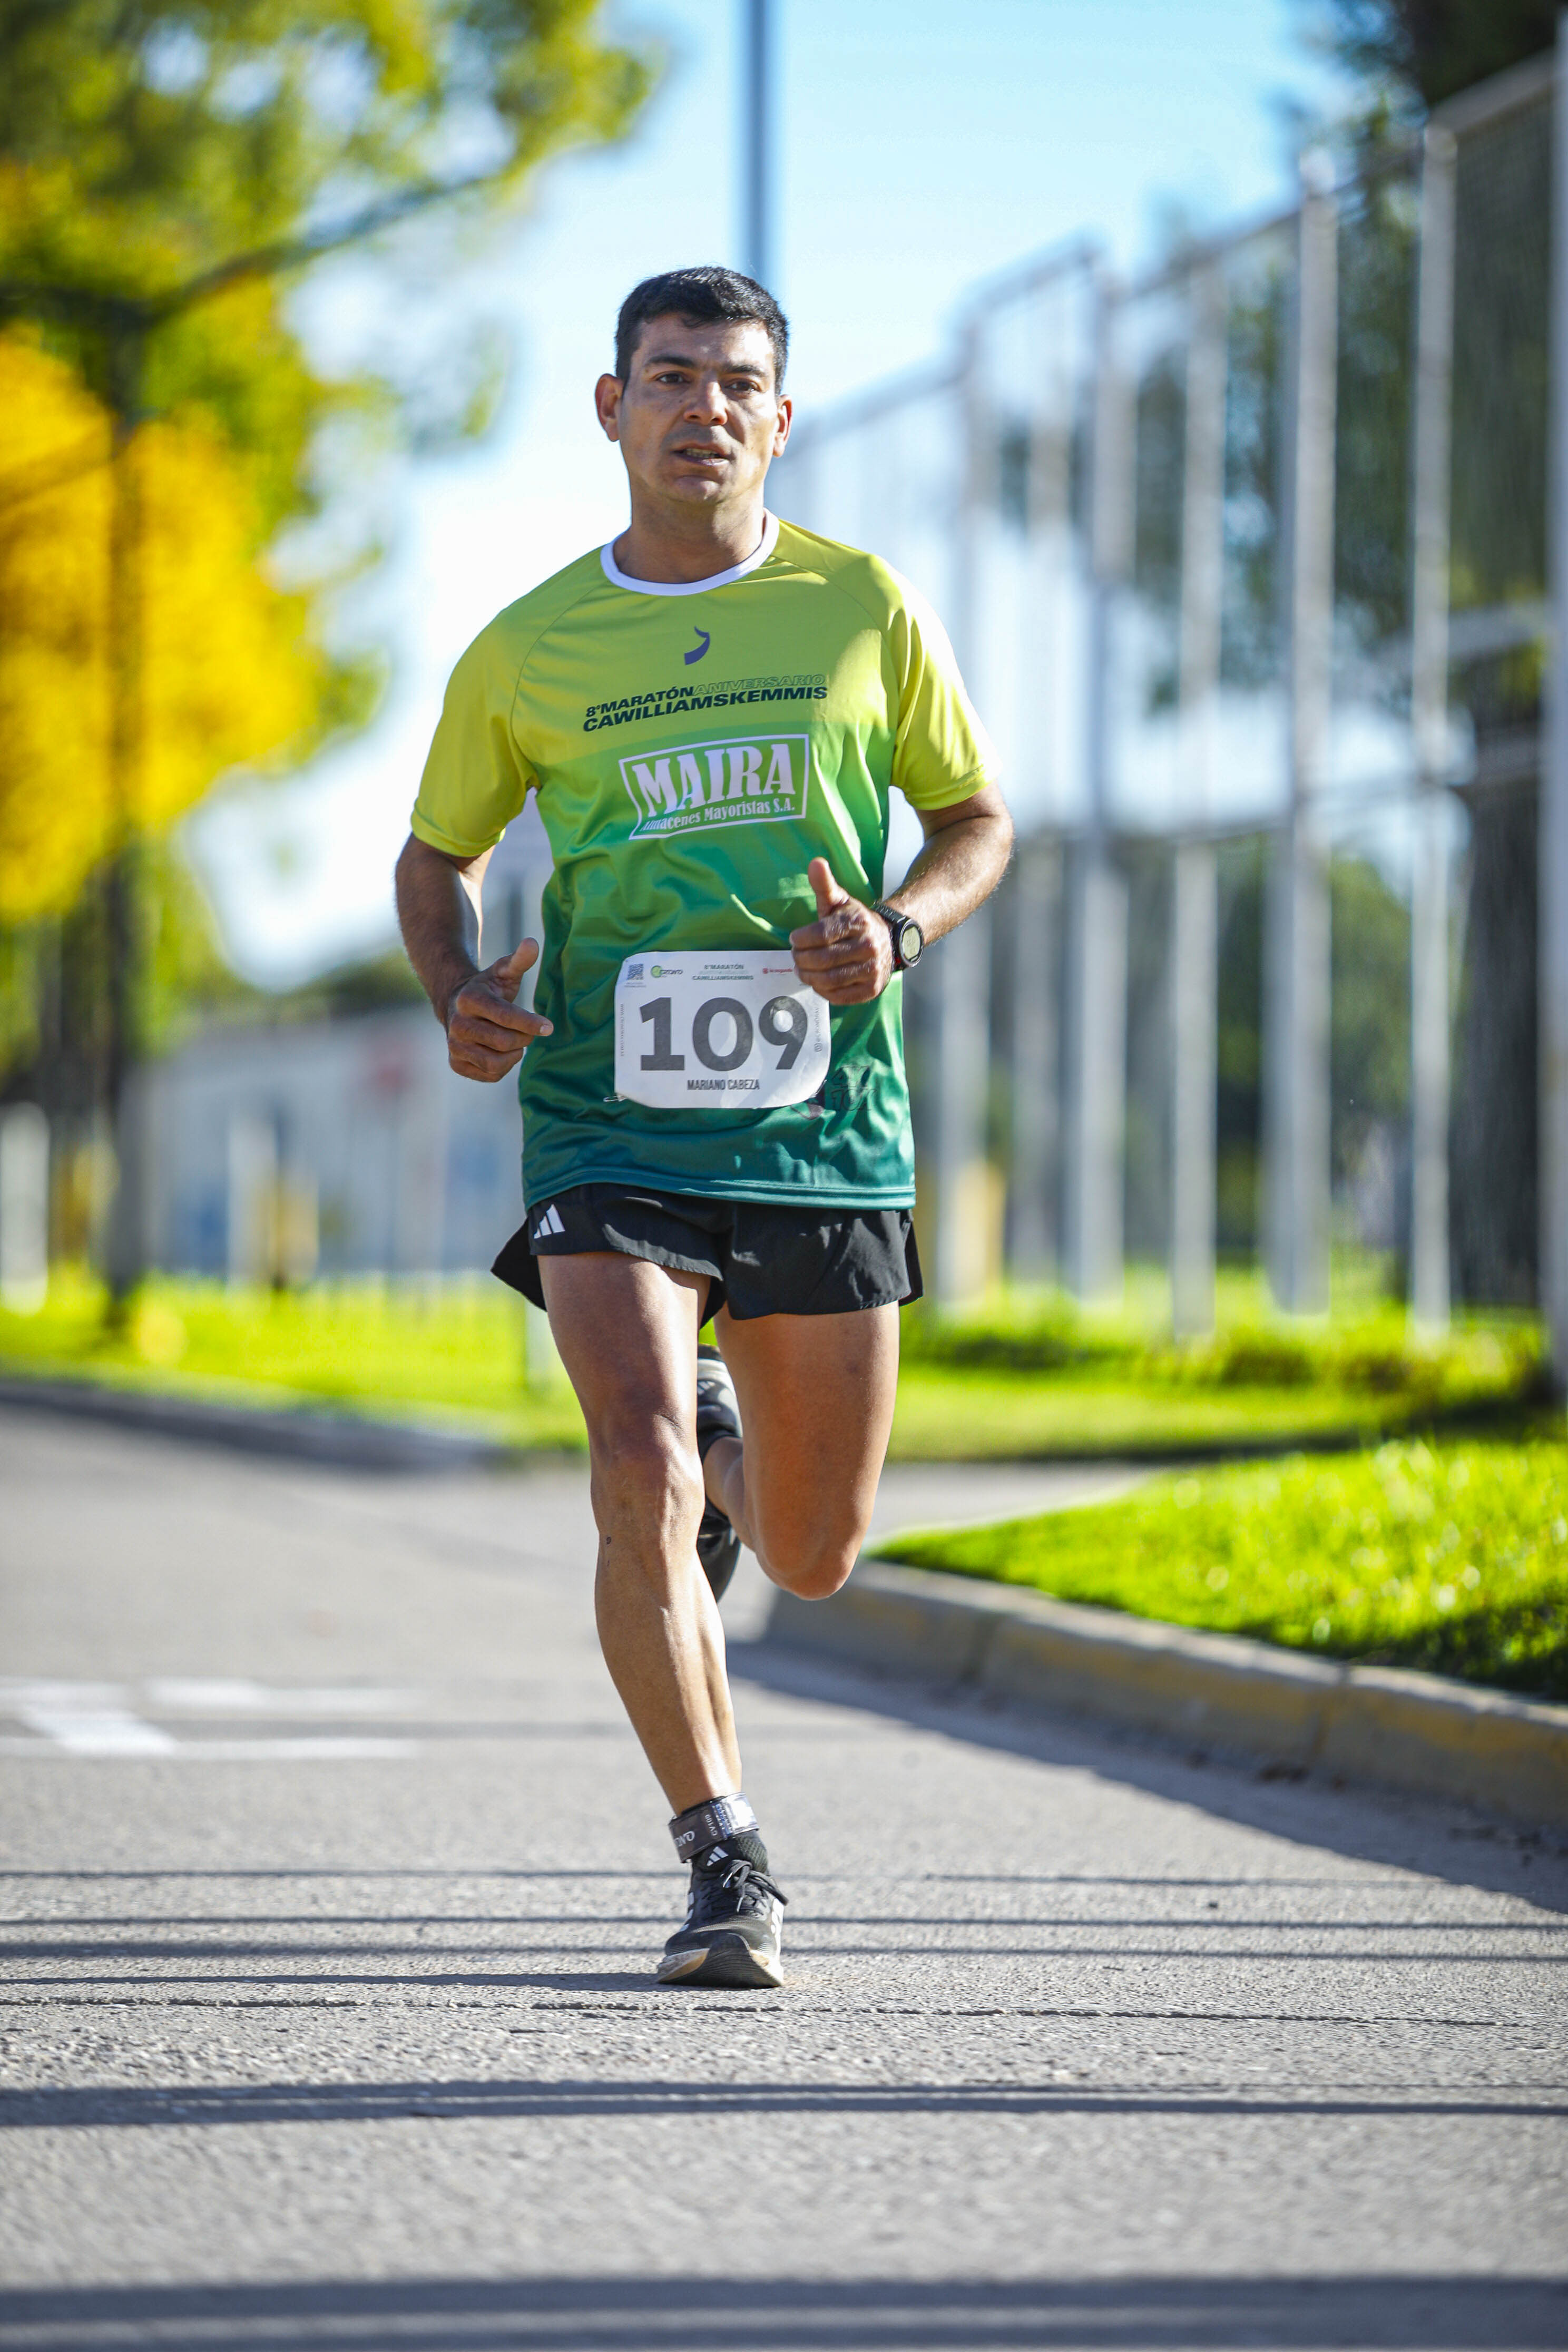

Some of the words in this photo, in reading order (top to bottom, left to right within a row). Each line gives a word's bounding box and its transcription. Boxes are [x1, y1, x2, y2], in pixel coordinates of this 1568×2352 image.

[583, 686, 828, 732] CAWILLIAMSKEMMIS
[632, 743, 796, 817] MAIRA
[640, 811, 701, 831] Almacenes
[704, 800, 770, 821] Mayoristas
[773, 797, 796, 814] S.A.
[639, 995, 808, 1072] 109
[687, 1079, 726, 1090] MARIANO
[728, 1079, 760, 1090] CABEZA
